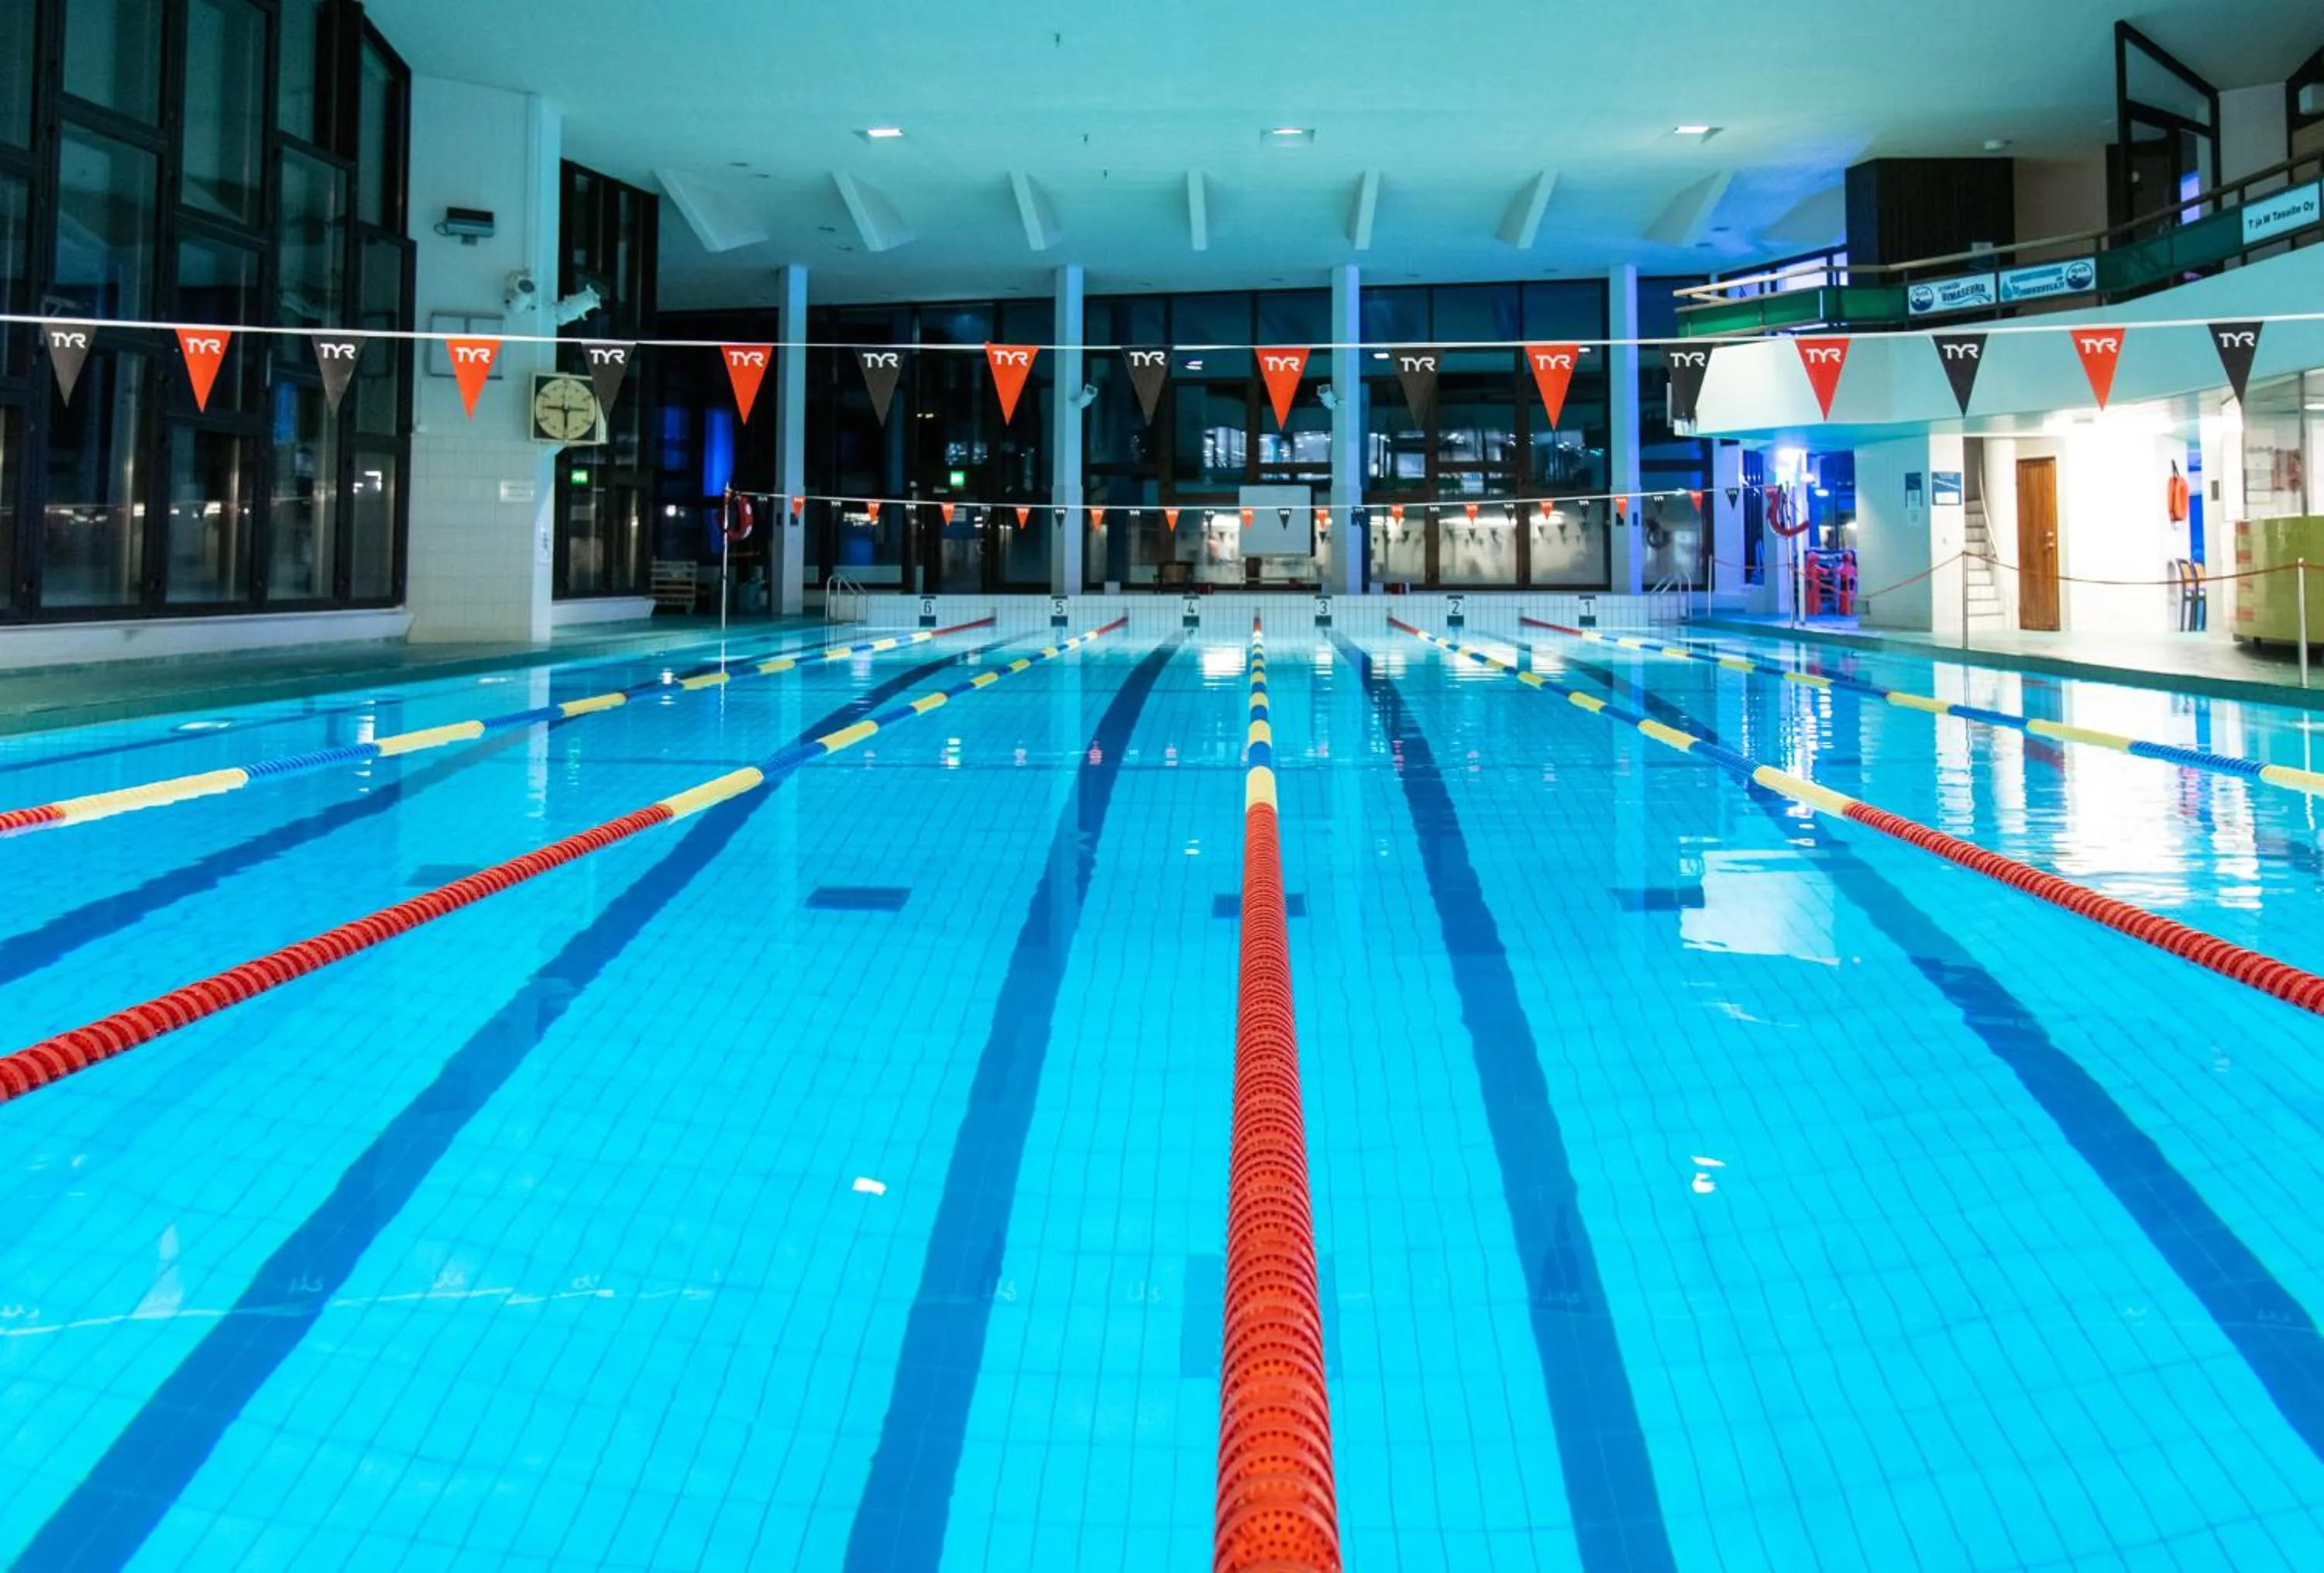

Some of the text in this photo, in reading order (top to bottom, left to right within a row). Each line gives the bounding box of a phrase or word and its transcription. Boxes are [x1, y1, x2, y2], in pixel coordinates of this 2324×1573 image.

[51, 332, 85, 347] TYR
[186, 338, 220, 353] TYR
[2080, 338, 2116, 353] TYR
[2219, 332, 2254, 347] TYR
[321, 343, 355, 359] TYR
[456, 347, 490, 362] TYR
[590, 349, 624, 363] TYR
[994, 350, 1027, 365] TYR
[1806, 348, 1841, 363] TYR
[1943, 344, 1978, 360] TYR
[730, 352, 763, 366] TYR
[863, 353, 897, 367] TYR
[1130, 352, 1164, 366] TYR
[1264, 357, 1299, 371] TYR
[1401, 357, 1435, 371] TYR
[1536, 355, 1570, 369] TYR
[1671, 353, 1706, 367] TYR
[923, 601, 932, 614] 6
[1055, 601, 1064, 614] 5
[1187, 601, 1195, 614] 4
[1319, 601, 1327, 614] 3
[1452, 601, 1459, 614] 2
